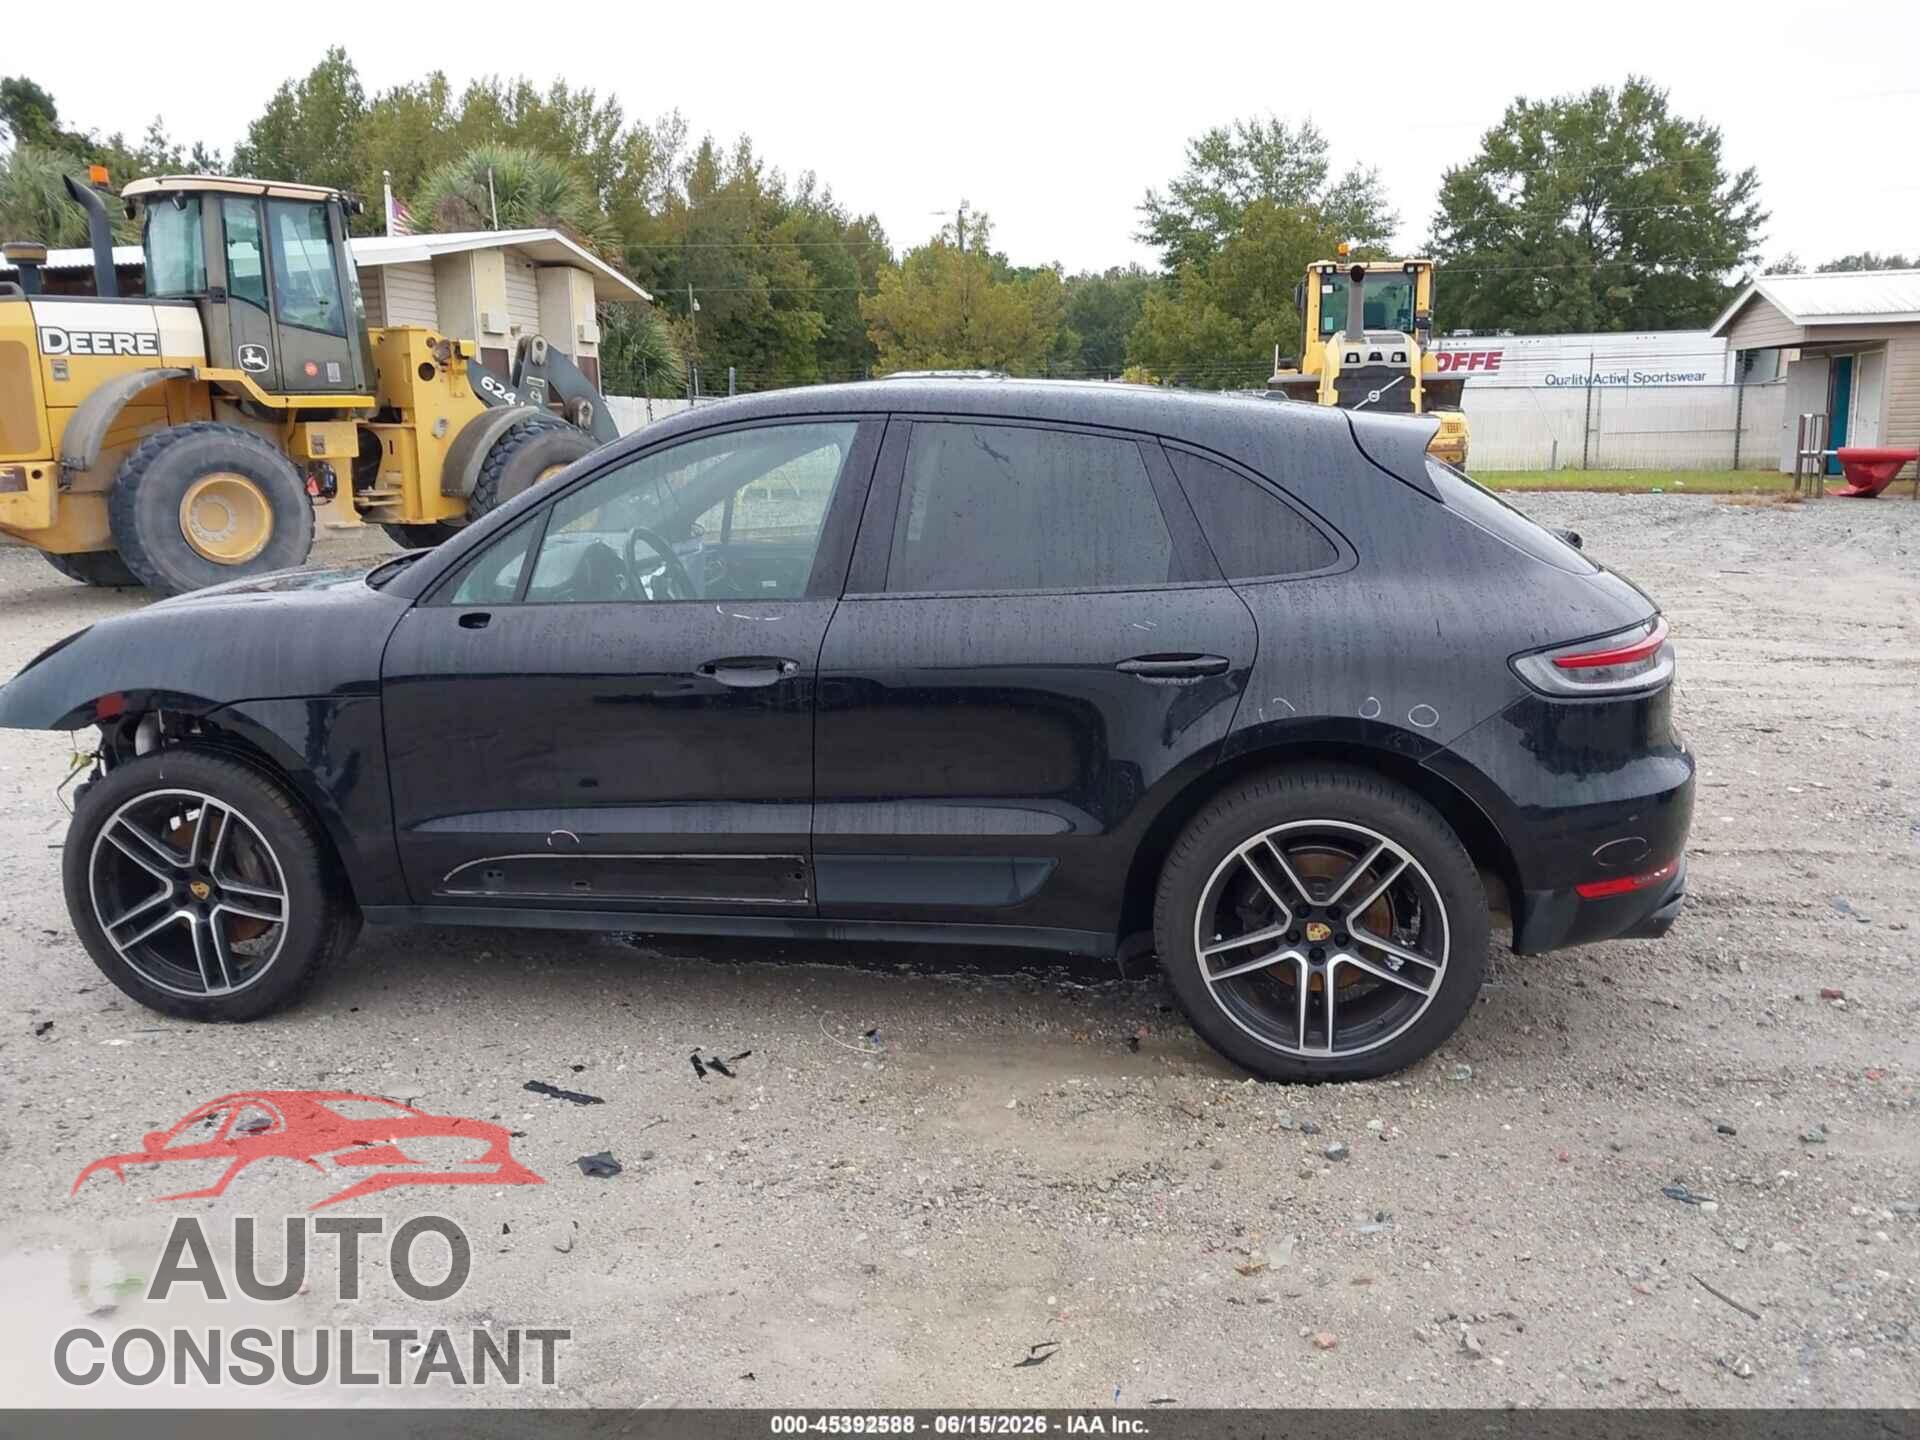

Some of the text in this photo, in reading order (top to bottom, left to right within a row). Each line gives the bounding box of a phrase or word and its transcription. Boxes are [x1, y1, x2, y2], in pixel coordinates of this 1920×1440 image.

[39, 326, 159, 356] DEERE
[1434, 351, 1504, 372] OFFE
[480, 376, 525, 407] 624
[1545, 371, 1707, 387] Quality Active Sportswear
